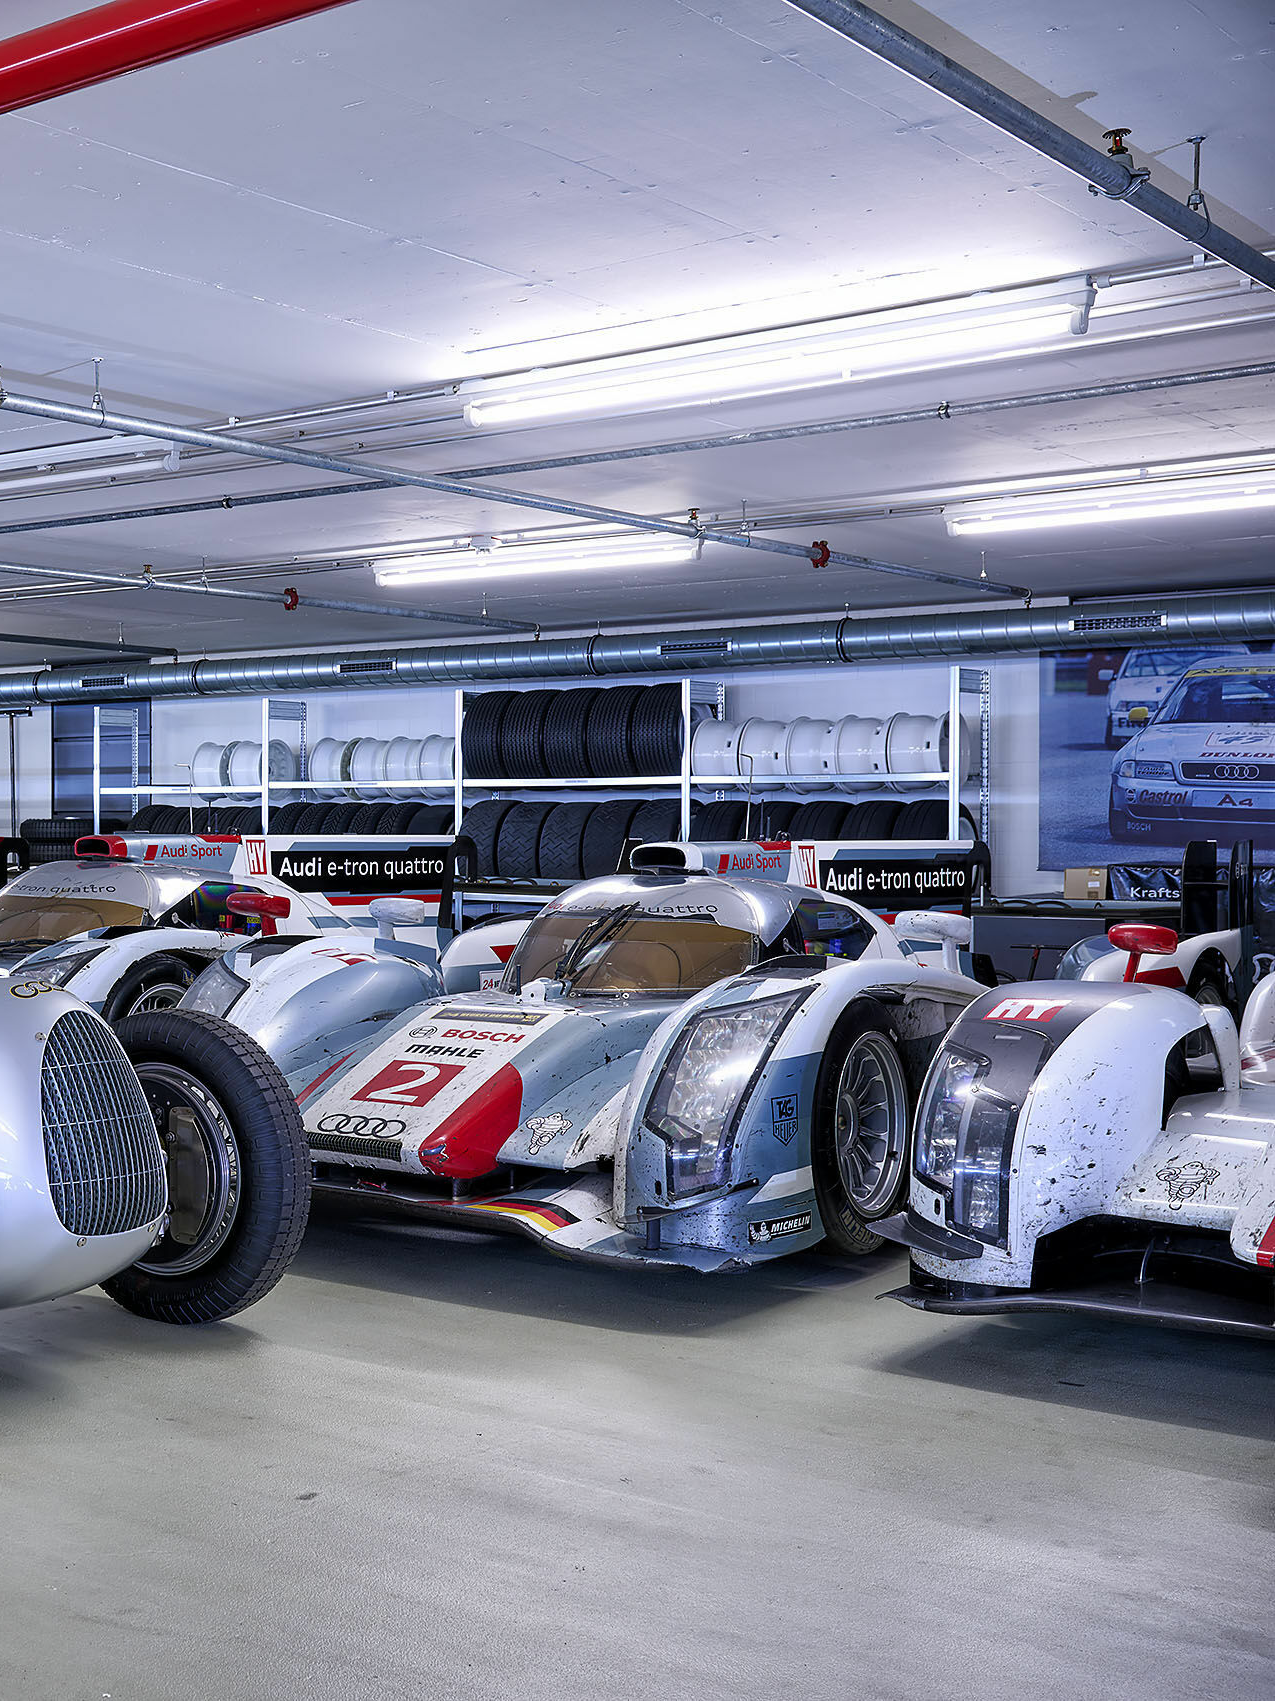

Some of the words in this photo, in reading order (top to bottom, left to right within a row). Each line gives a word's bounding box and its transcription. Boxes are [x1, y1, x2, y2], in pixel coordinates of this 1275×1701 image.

[1139, 789, 1189, 804] Castrol
[1217, 794, 1253, 807] A4
[161, 844, 188, 857] Audi
[191, 844, 222, 860] Sport
[279, 856, 322, 877] Audi
[327, 858, 379, 876] e-tron
[384, 857, 444, 880] quattro
[732, 854, 755, 871] Audi
[757, 853, 782, 873] Sport
[825, 867, 863, 891] Audi
[867, 869, 910, 890] e-tron
[915, 869, 966, 893] quattro
[50, 884, 116, 896] quattro
[1130, 887, 1182, 898] Krafts
[482, 978, 494, 990] 24
[441, 1029, 525, 1044] BOSCH
[405, 1044, 485, 1058] MAHLE
[366, 1063, 441, 1103] 2
[776, 1098, 794, 1118] TAG
[775, 1122, 797, 1142] HEUER
[771, 1215, 811, 1233] MICHELIN
